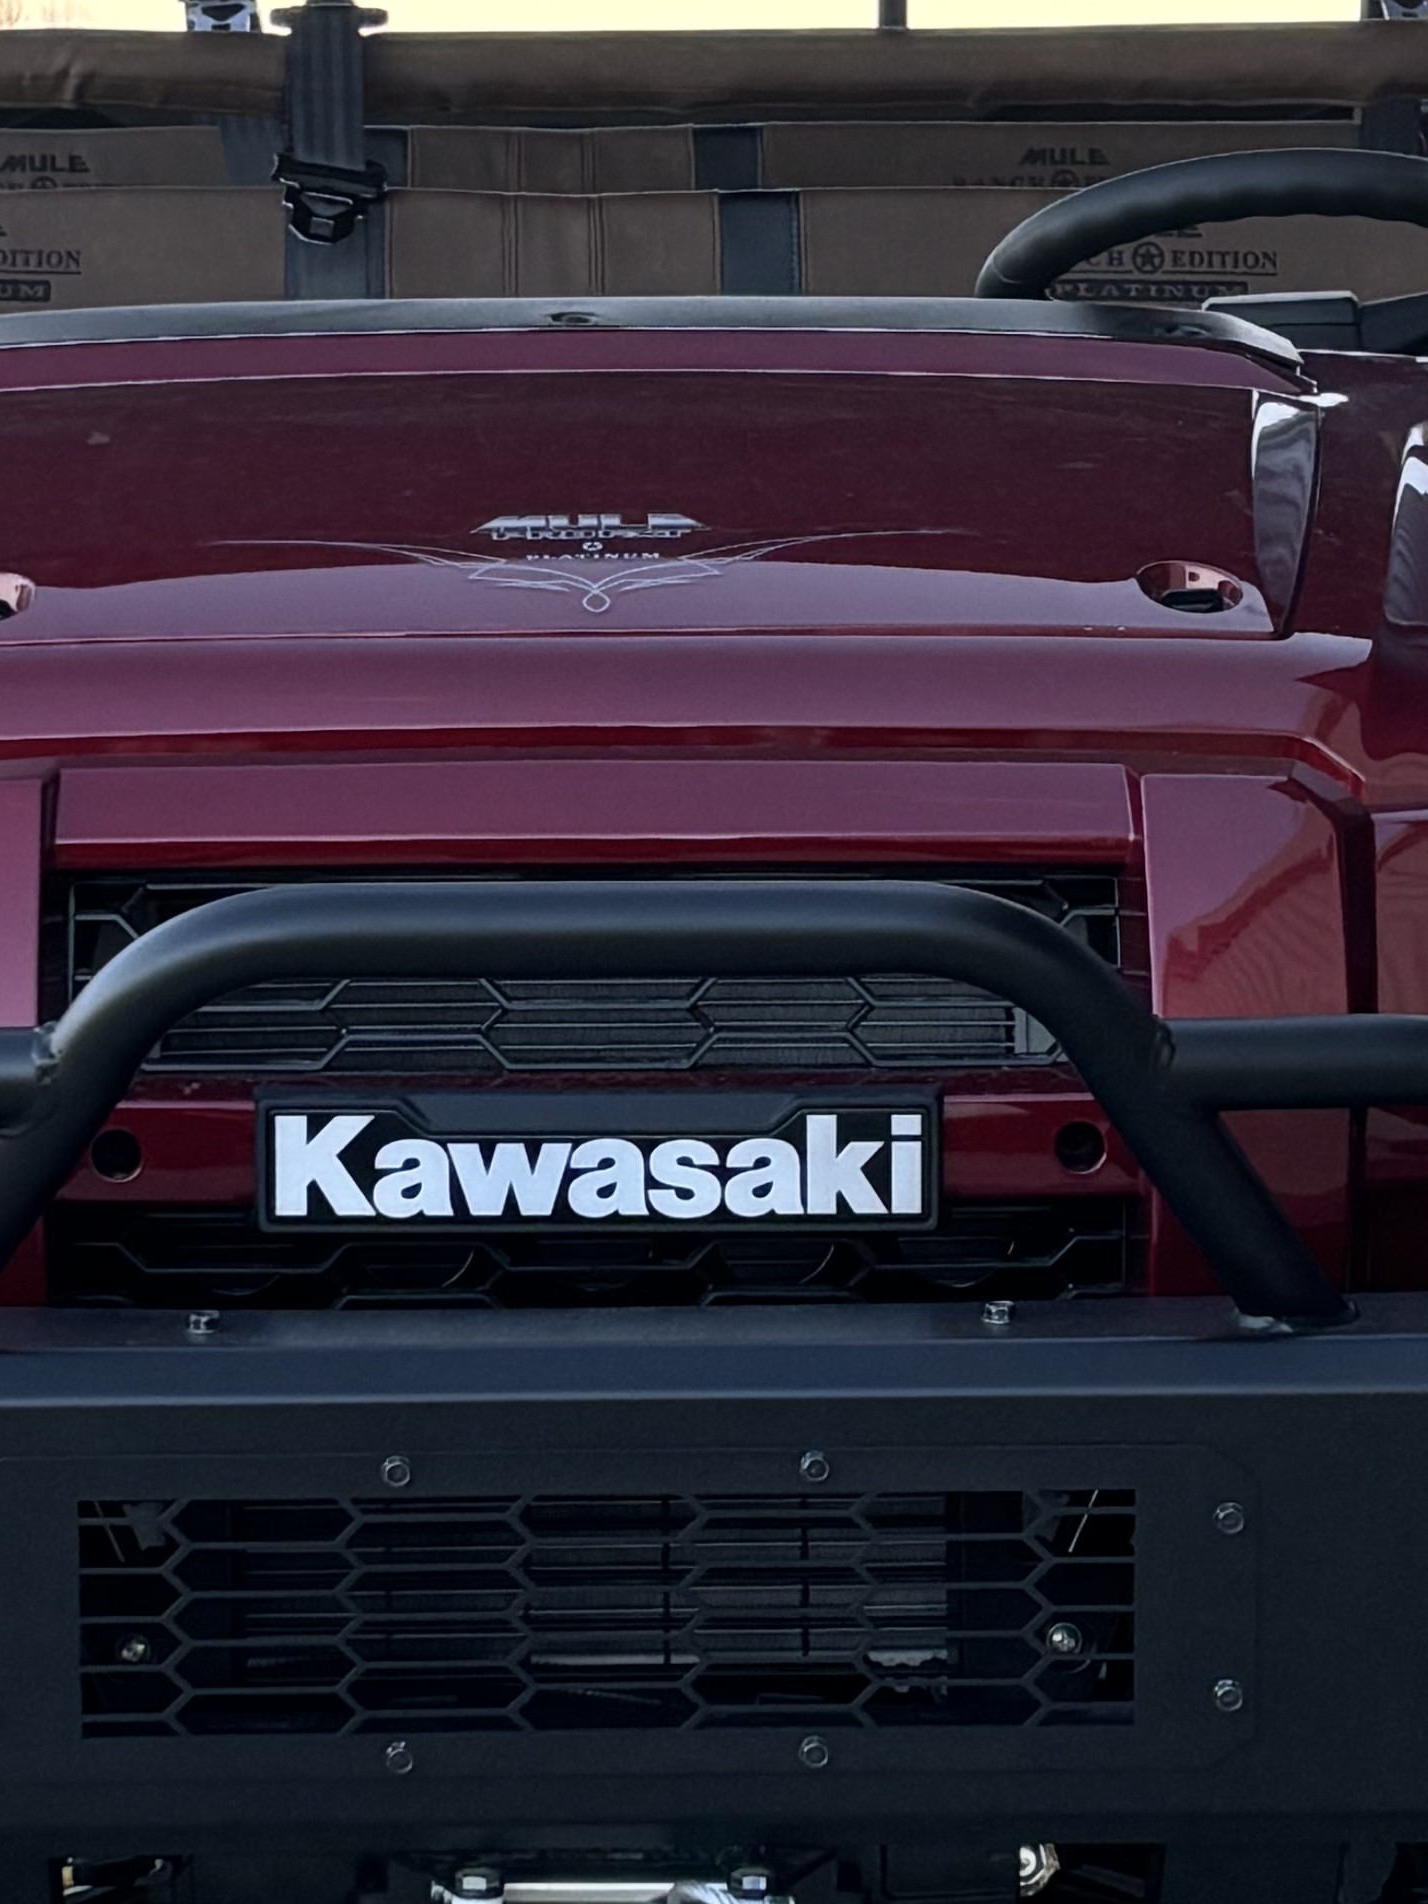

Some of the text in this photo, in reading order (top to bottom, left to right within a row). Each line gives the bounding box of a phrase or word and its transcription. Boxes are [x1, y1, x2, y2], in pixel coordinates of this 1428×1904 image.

[1019, 147, 1111, 166] MULE
[1170, 251, 1279, 270] EDITION
[273, 1113, 922, 1220] Kawasaki
